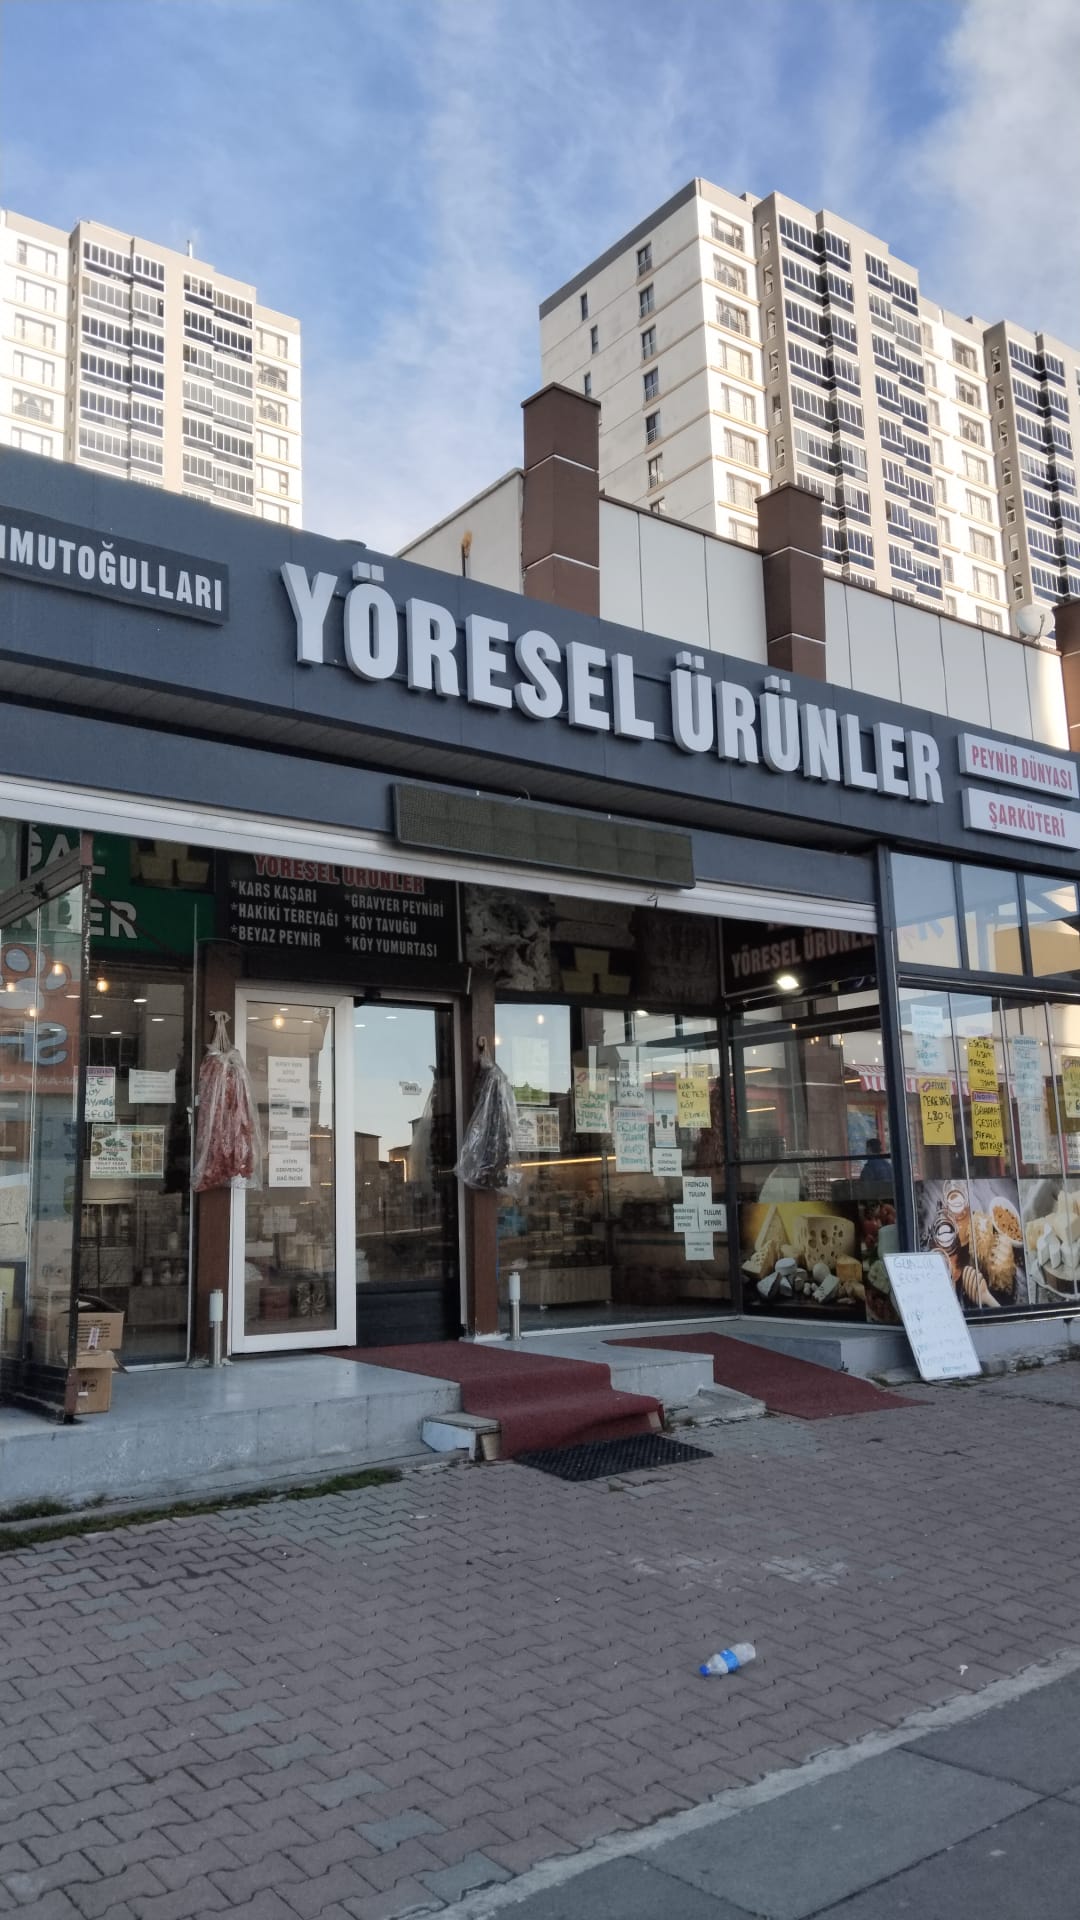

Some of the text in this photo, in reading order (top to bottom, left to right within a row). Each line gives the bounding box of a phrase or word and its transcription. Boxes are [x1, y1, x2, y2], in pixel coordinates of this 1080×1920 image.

[281, 561, 945, 804] YÖRESEL ÜRÜNLER
[971, 744, 1073, 791] PEYNİR DÜNYASI
[988, 801, 1067, 838] ŞARKÜTERİ
[238, 881, 317, 904] KARS KAŞARI
[238, 903, 338, 927] HAKİKİ TEREYAĞI
[351, 894, 444, 917] GRAVYER PEYNİRİ
[352, 913, 417, 935] KÖY TAVUĞU
[239, 926, 321, 947] BEYAZ PEYNİR
[352, 934, 437, 957] KÖY YUMURTASI
[731, 938, 801, 978] YÖRESEL
